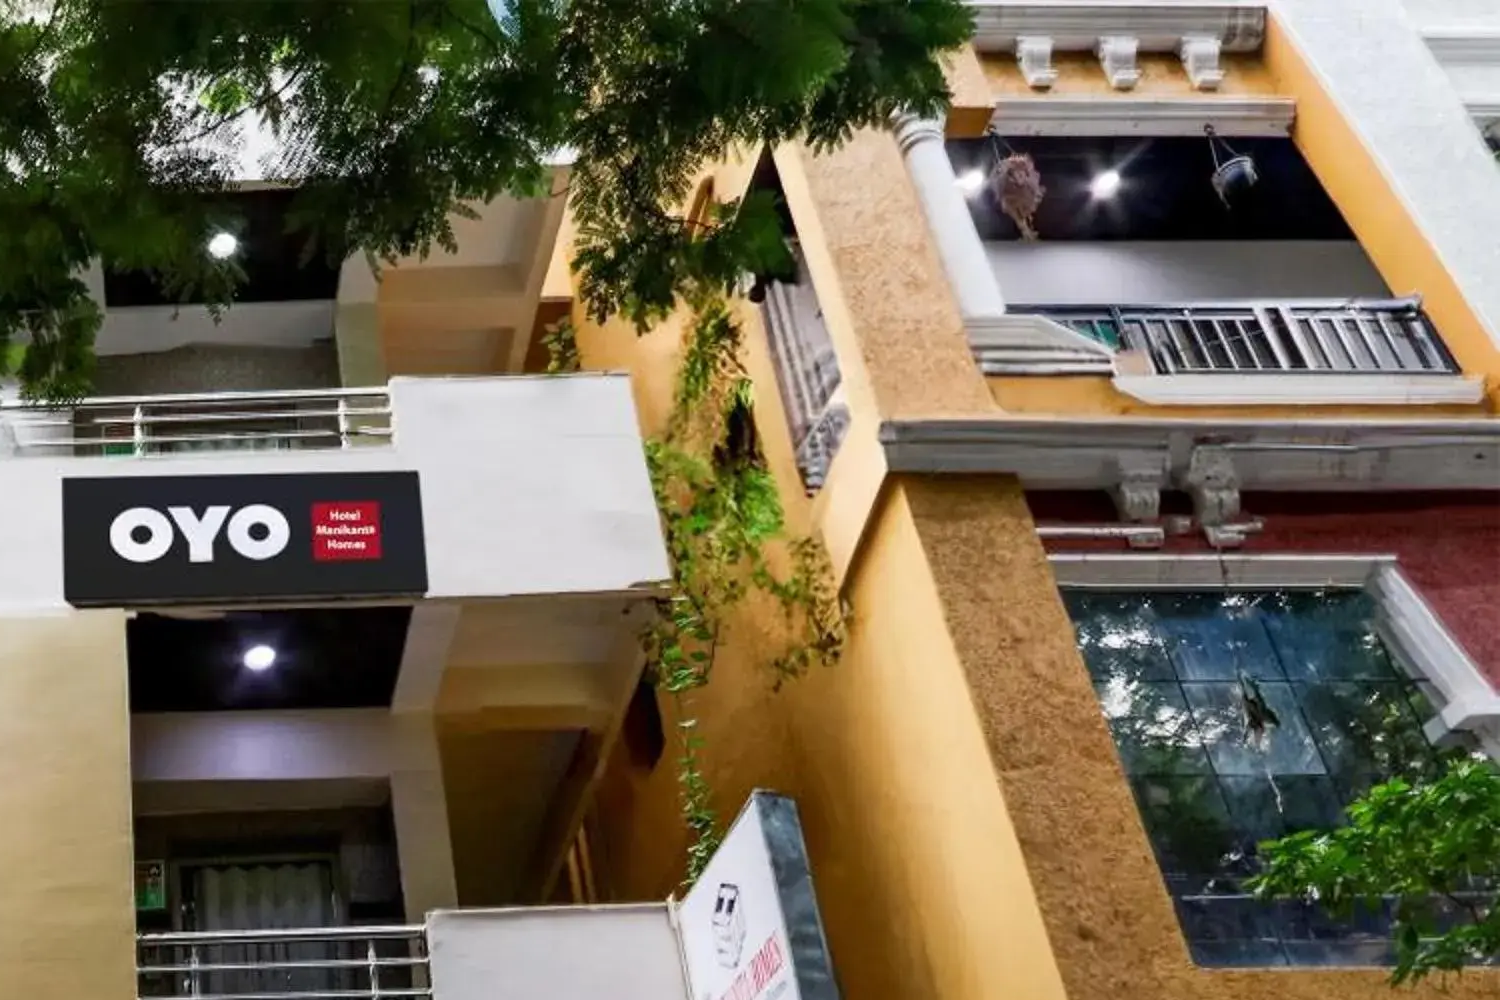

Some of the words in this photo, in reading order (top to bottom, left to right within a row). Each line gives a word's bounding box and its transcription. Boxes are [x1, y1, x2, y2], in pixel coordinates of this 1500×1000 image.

[329, 509, 361, 521] Hotel
[109, 504, 290, 563] OYO
[327, 539, 367, 550] Homes
